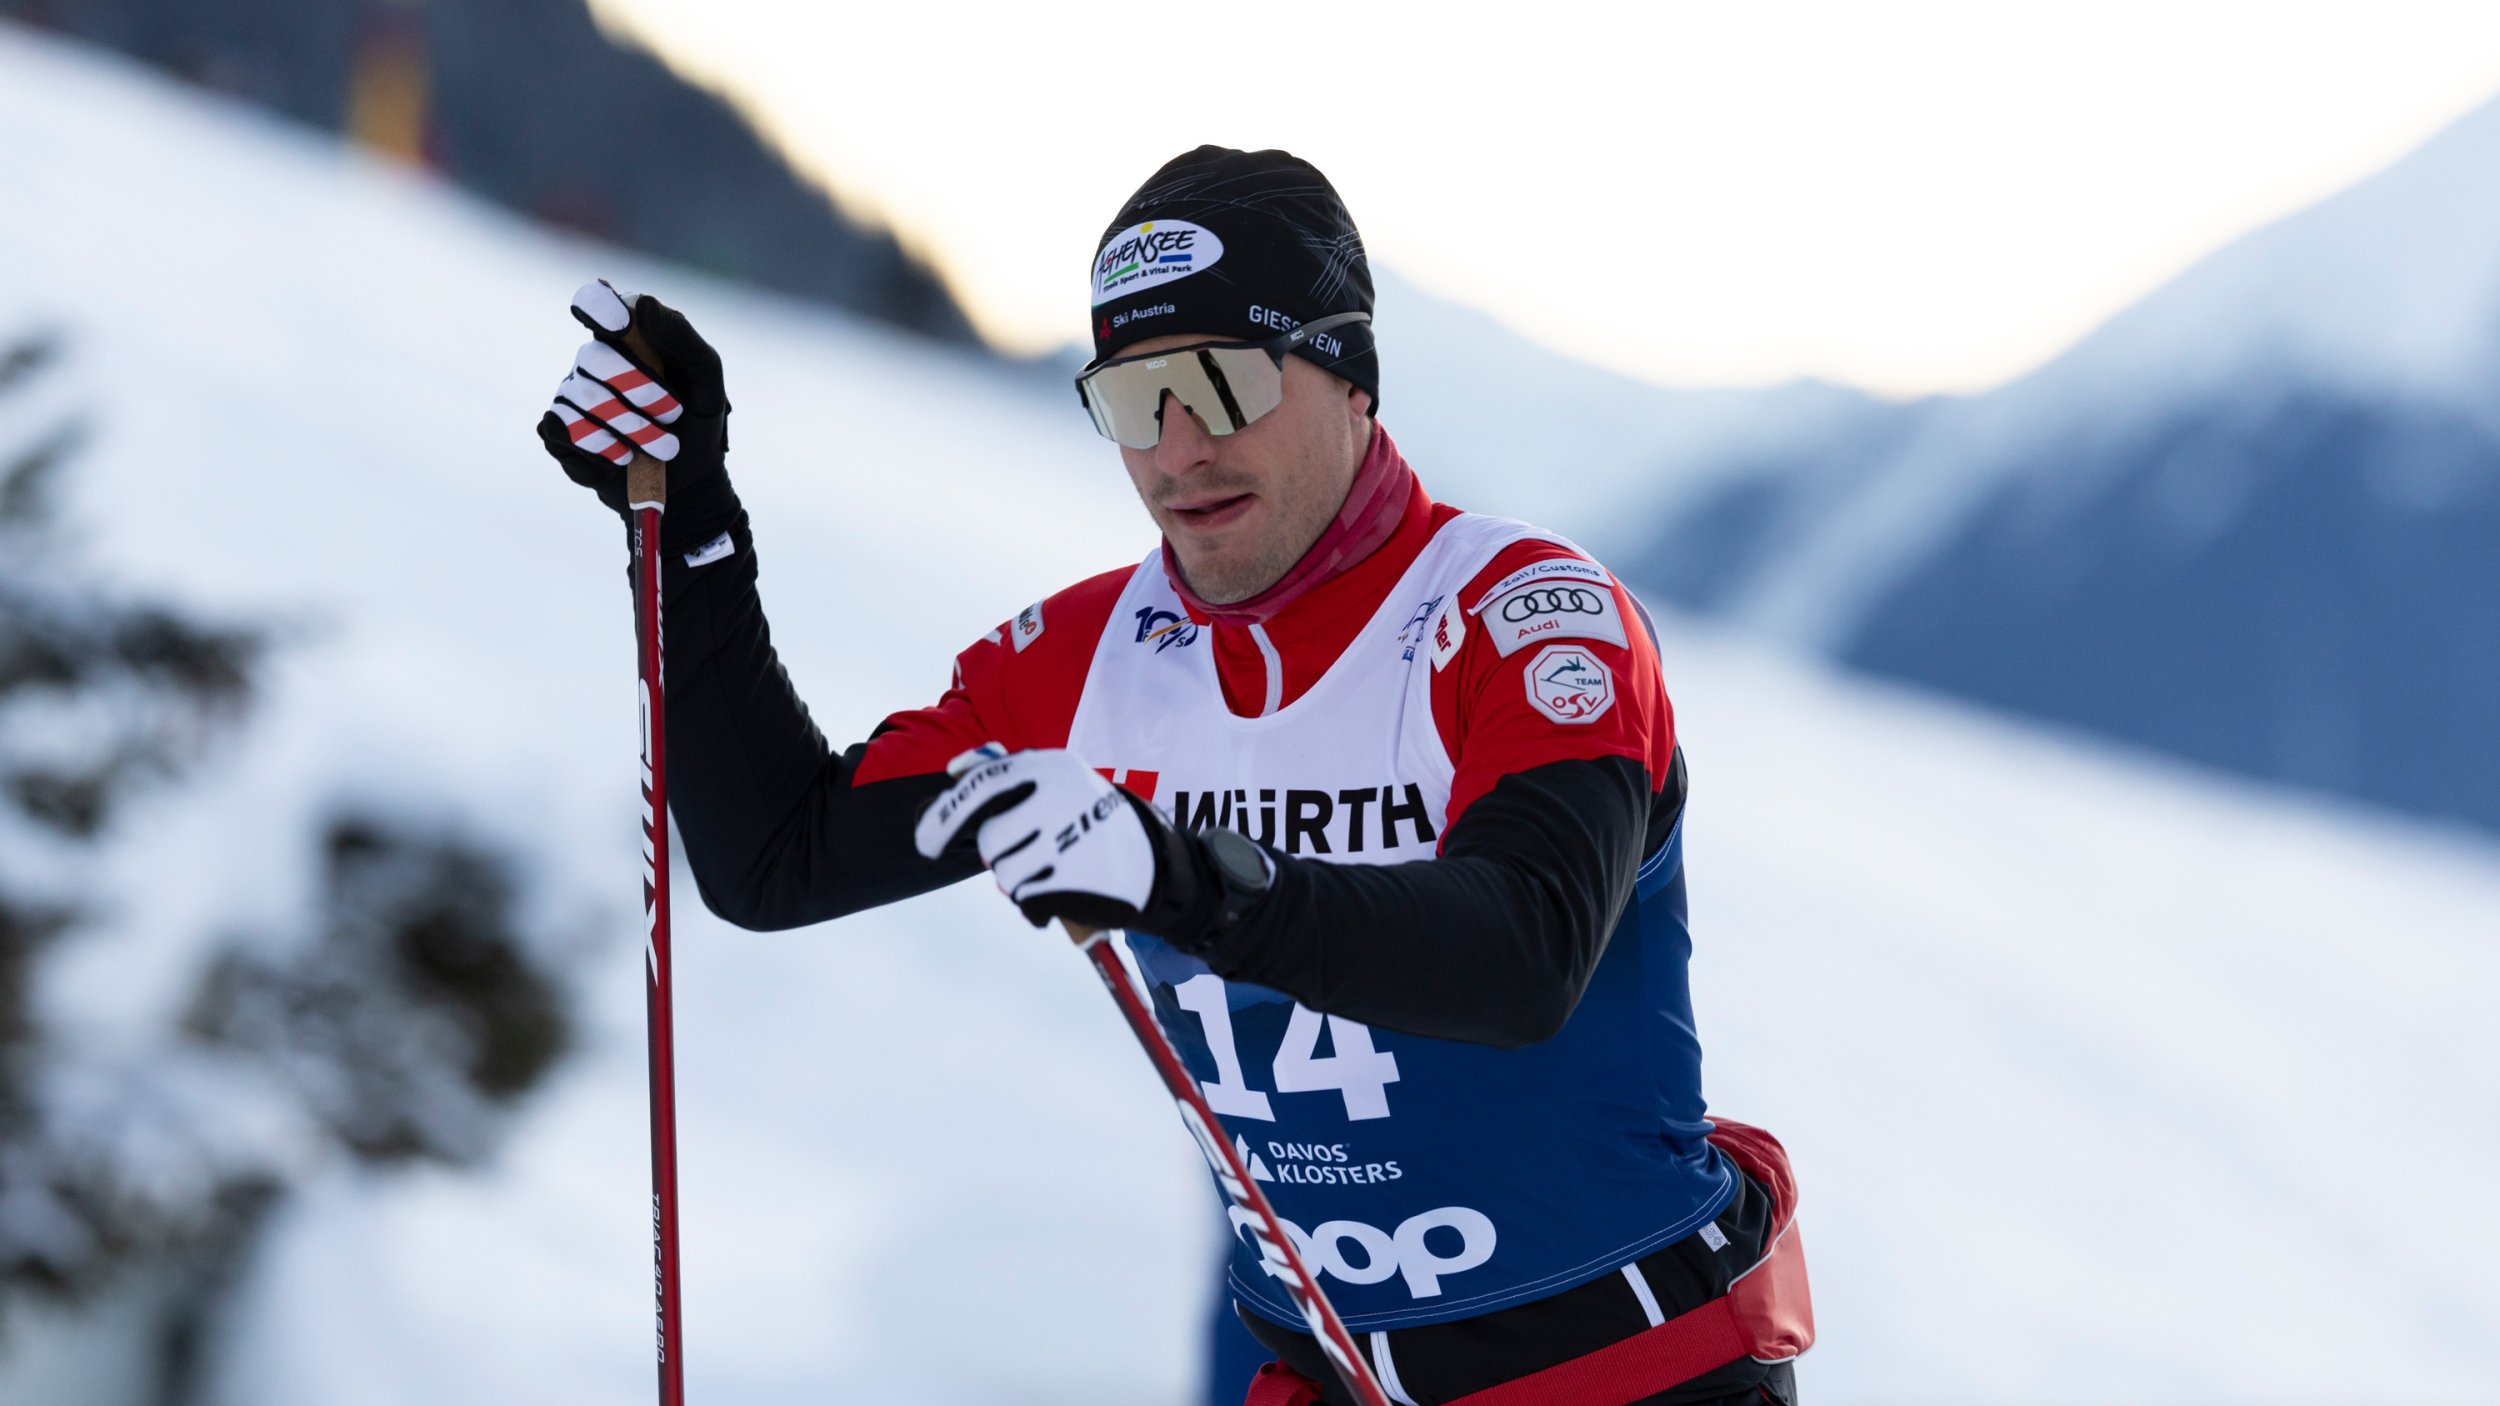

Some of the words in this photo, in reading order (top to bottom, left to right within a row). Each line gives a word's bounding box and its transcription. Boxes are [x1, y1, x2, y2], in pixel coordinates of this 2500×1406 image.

[1119, 272, 1140, 286] Sport
[1141, 268, 1148, 278] &
[1149, 264, 1170, 275] Vital
[1171, 264, 1193, 273] Park
[1113, 312, 1129, 328] Ski
[1131, 302, 1176, 321] Austria
[1517, 619, 1560, 640] Audi
[1575, 678, 1602, 686] TEAM
[1174, 974, 1400, 1122] 14
[1267, 1141, 1348, 1163] DAVOS
[1276, 1160, 1403, 1185] KLOSTERS
